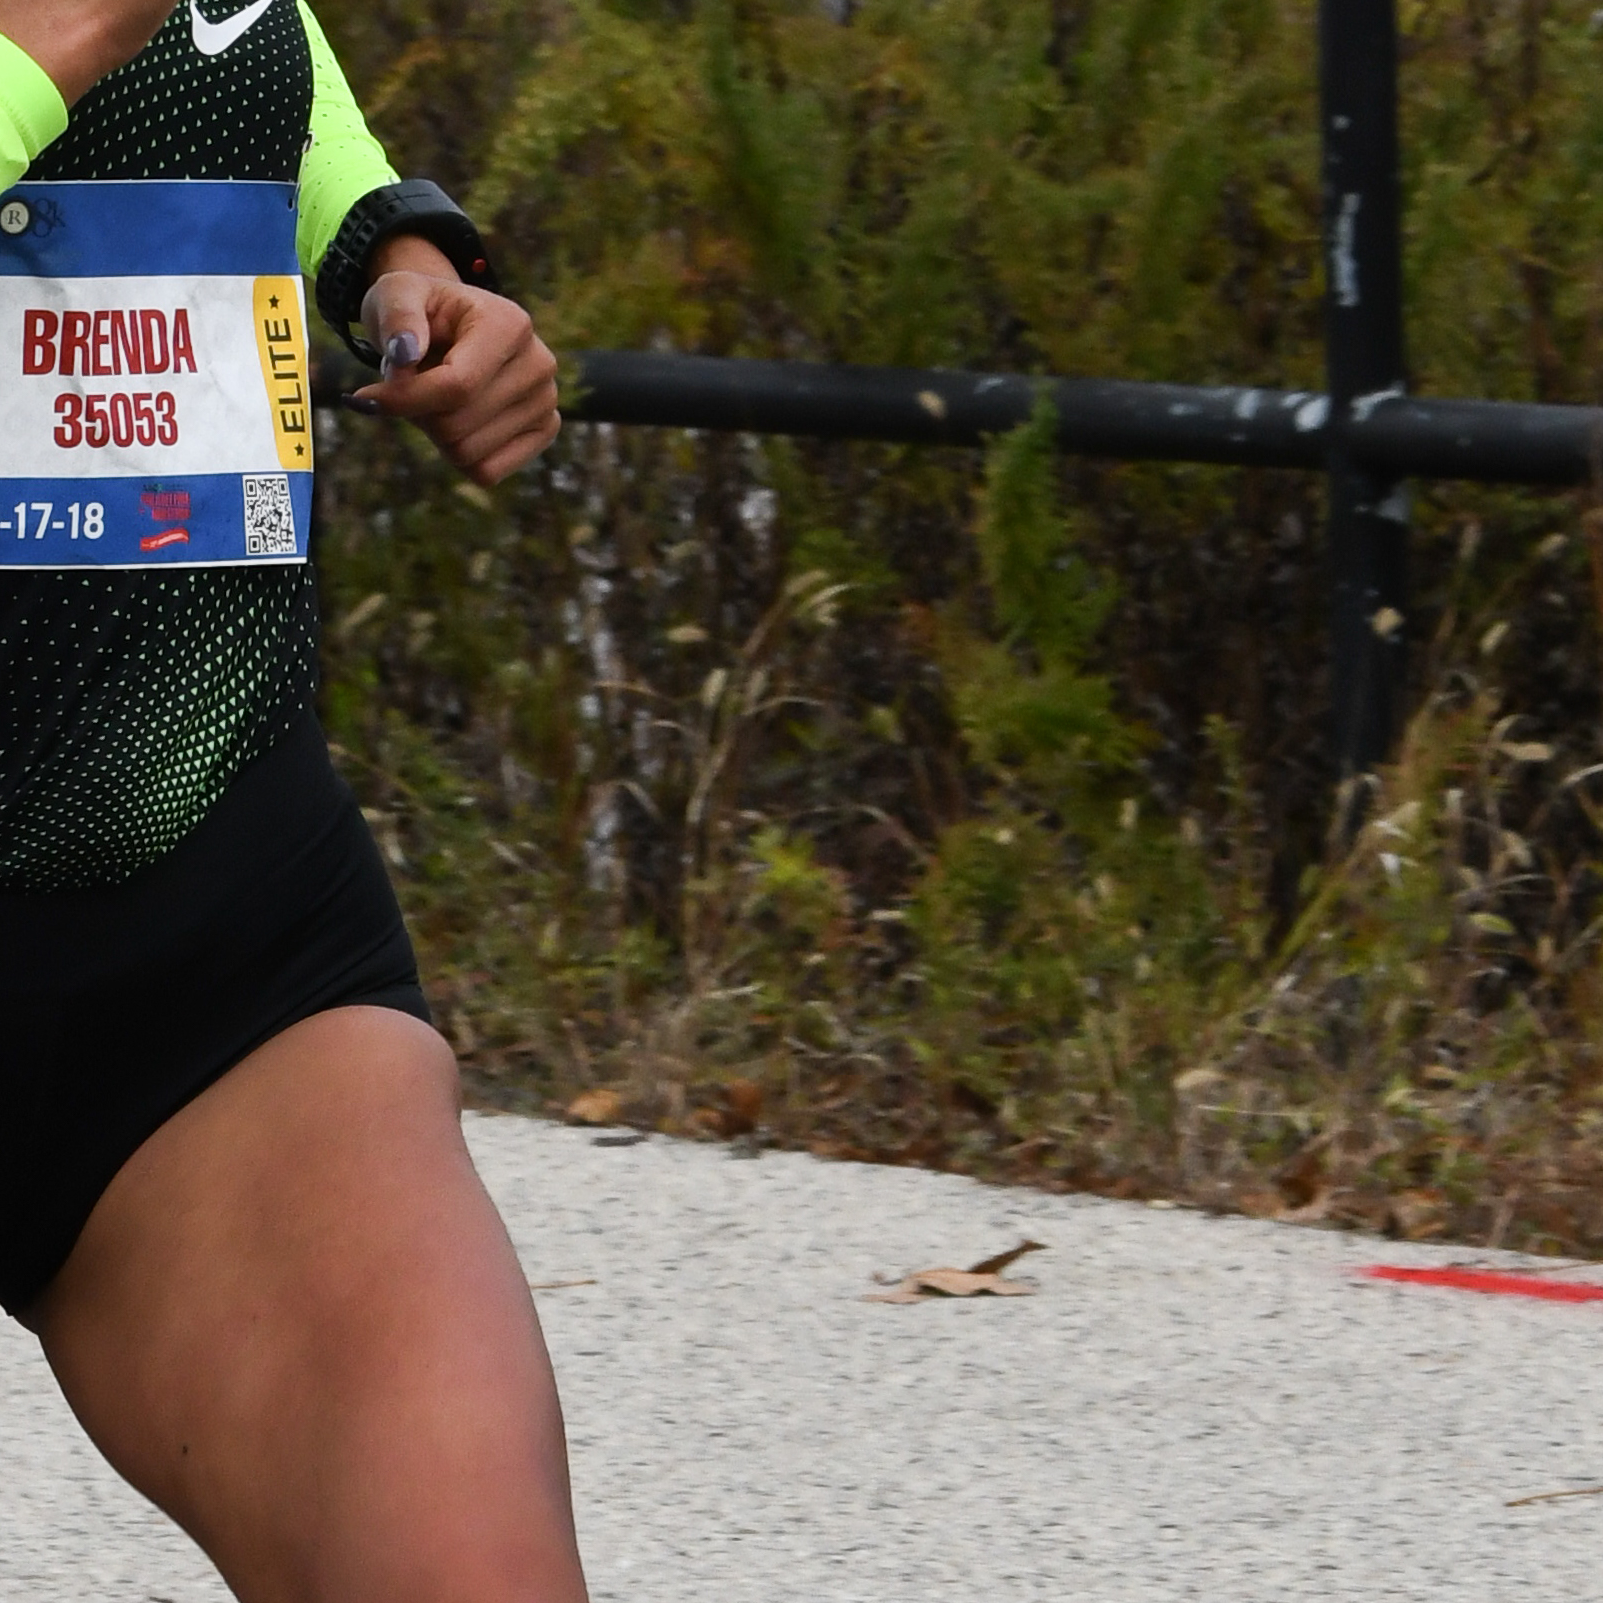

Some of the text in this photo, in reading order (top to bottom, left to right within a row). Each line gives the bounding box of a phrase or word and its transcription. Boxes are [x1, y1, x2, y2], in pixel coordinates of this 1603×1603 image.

[22, 308, 199, 377] BRENDA
[264, 318, 306, 433] ELITE
[53, 391, 179, 449] 35053
